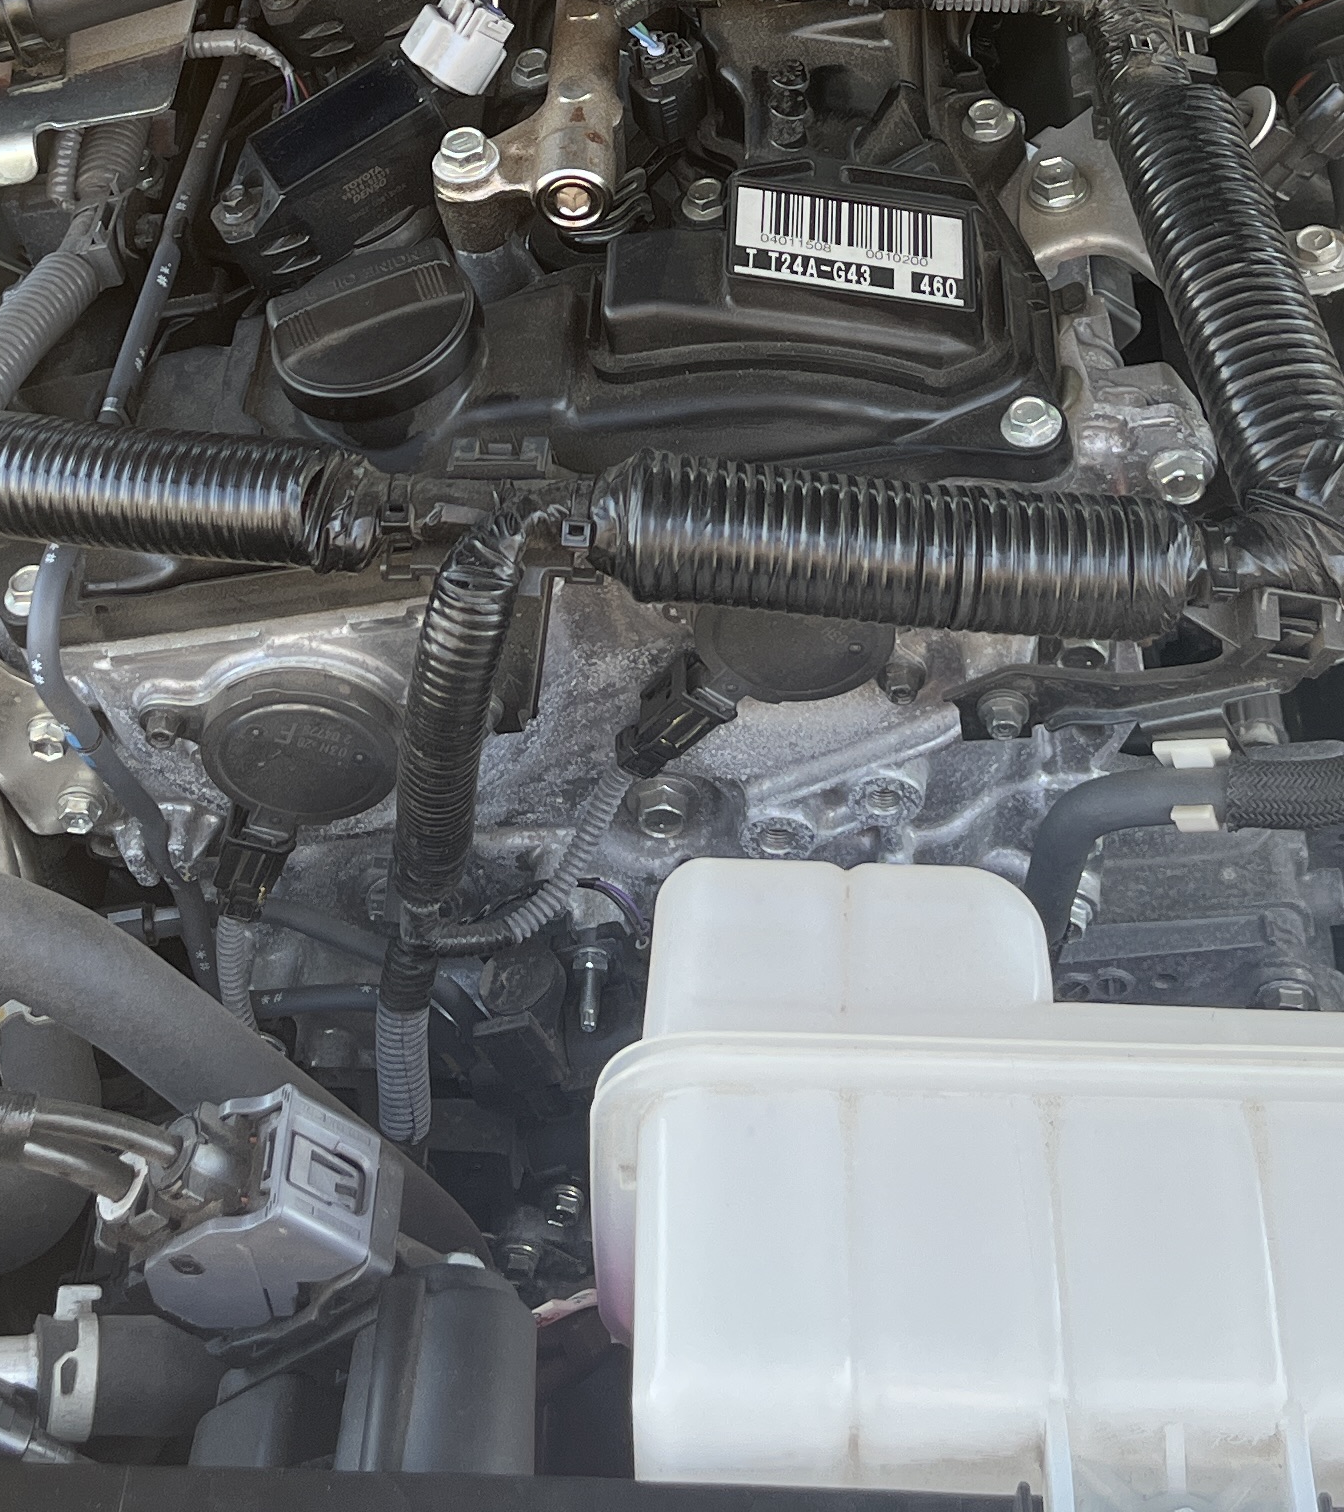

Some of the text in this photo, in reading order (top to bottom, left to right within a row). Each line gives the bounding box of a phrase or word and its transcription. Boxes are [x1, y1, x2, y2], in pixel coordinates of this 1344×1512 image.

[342, 165, 386, 192] TOYOTA
[353, 177, 387, 204] DENSO
[760, 233, 929, 267] 04011508 0010200
[746, 247, 957, 300] T T24A-G43 460
